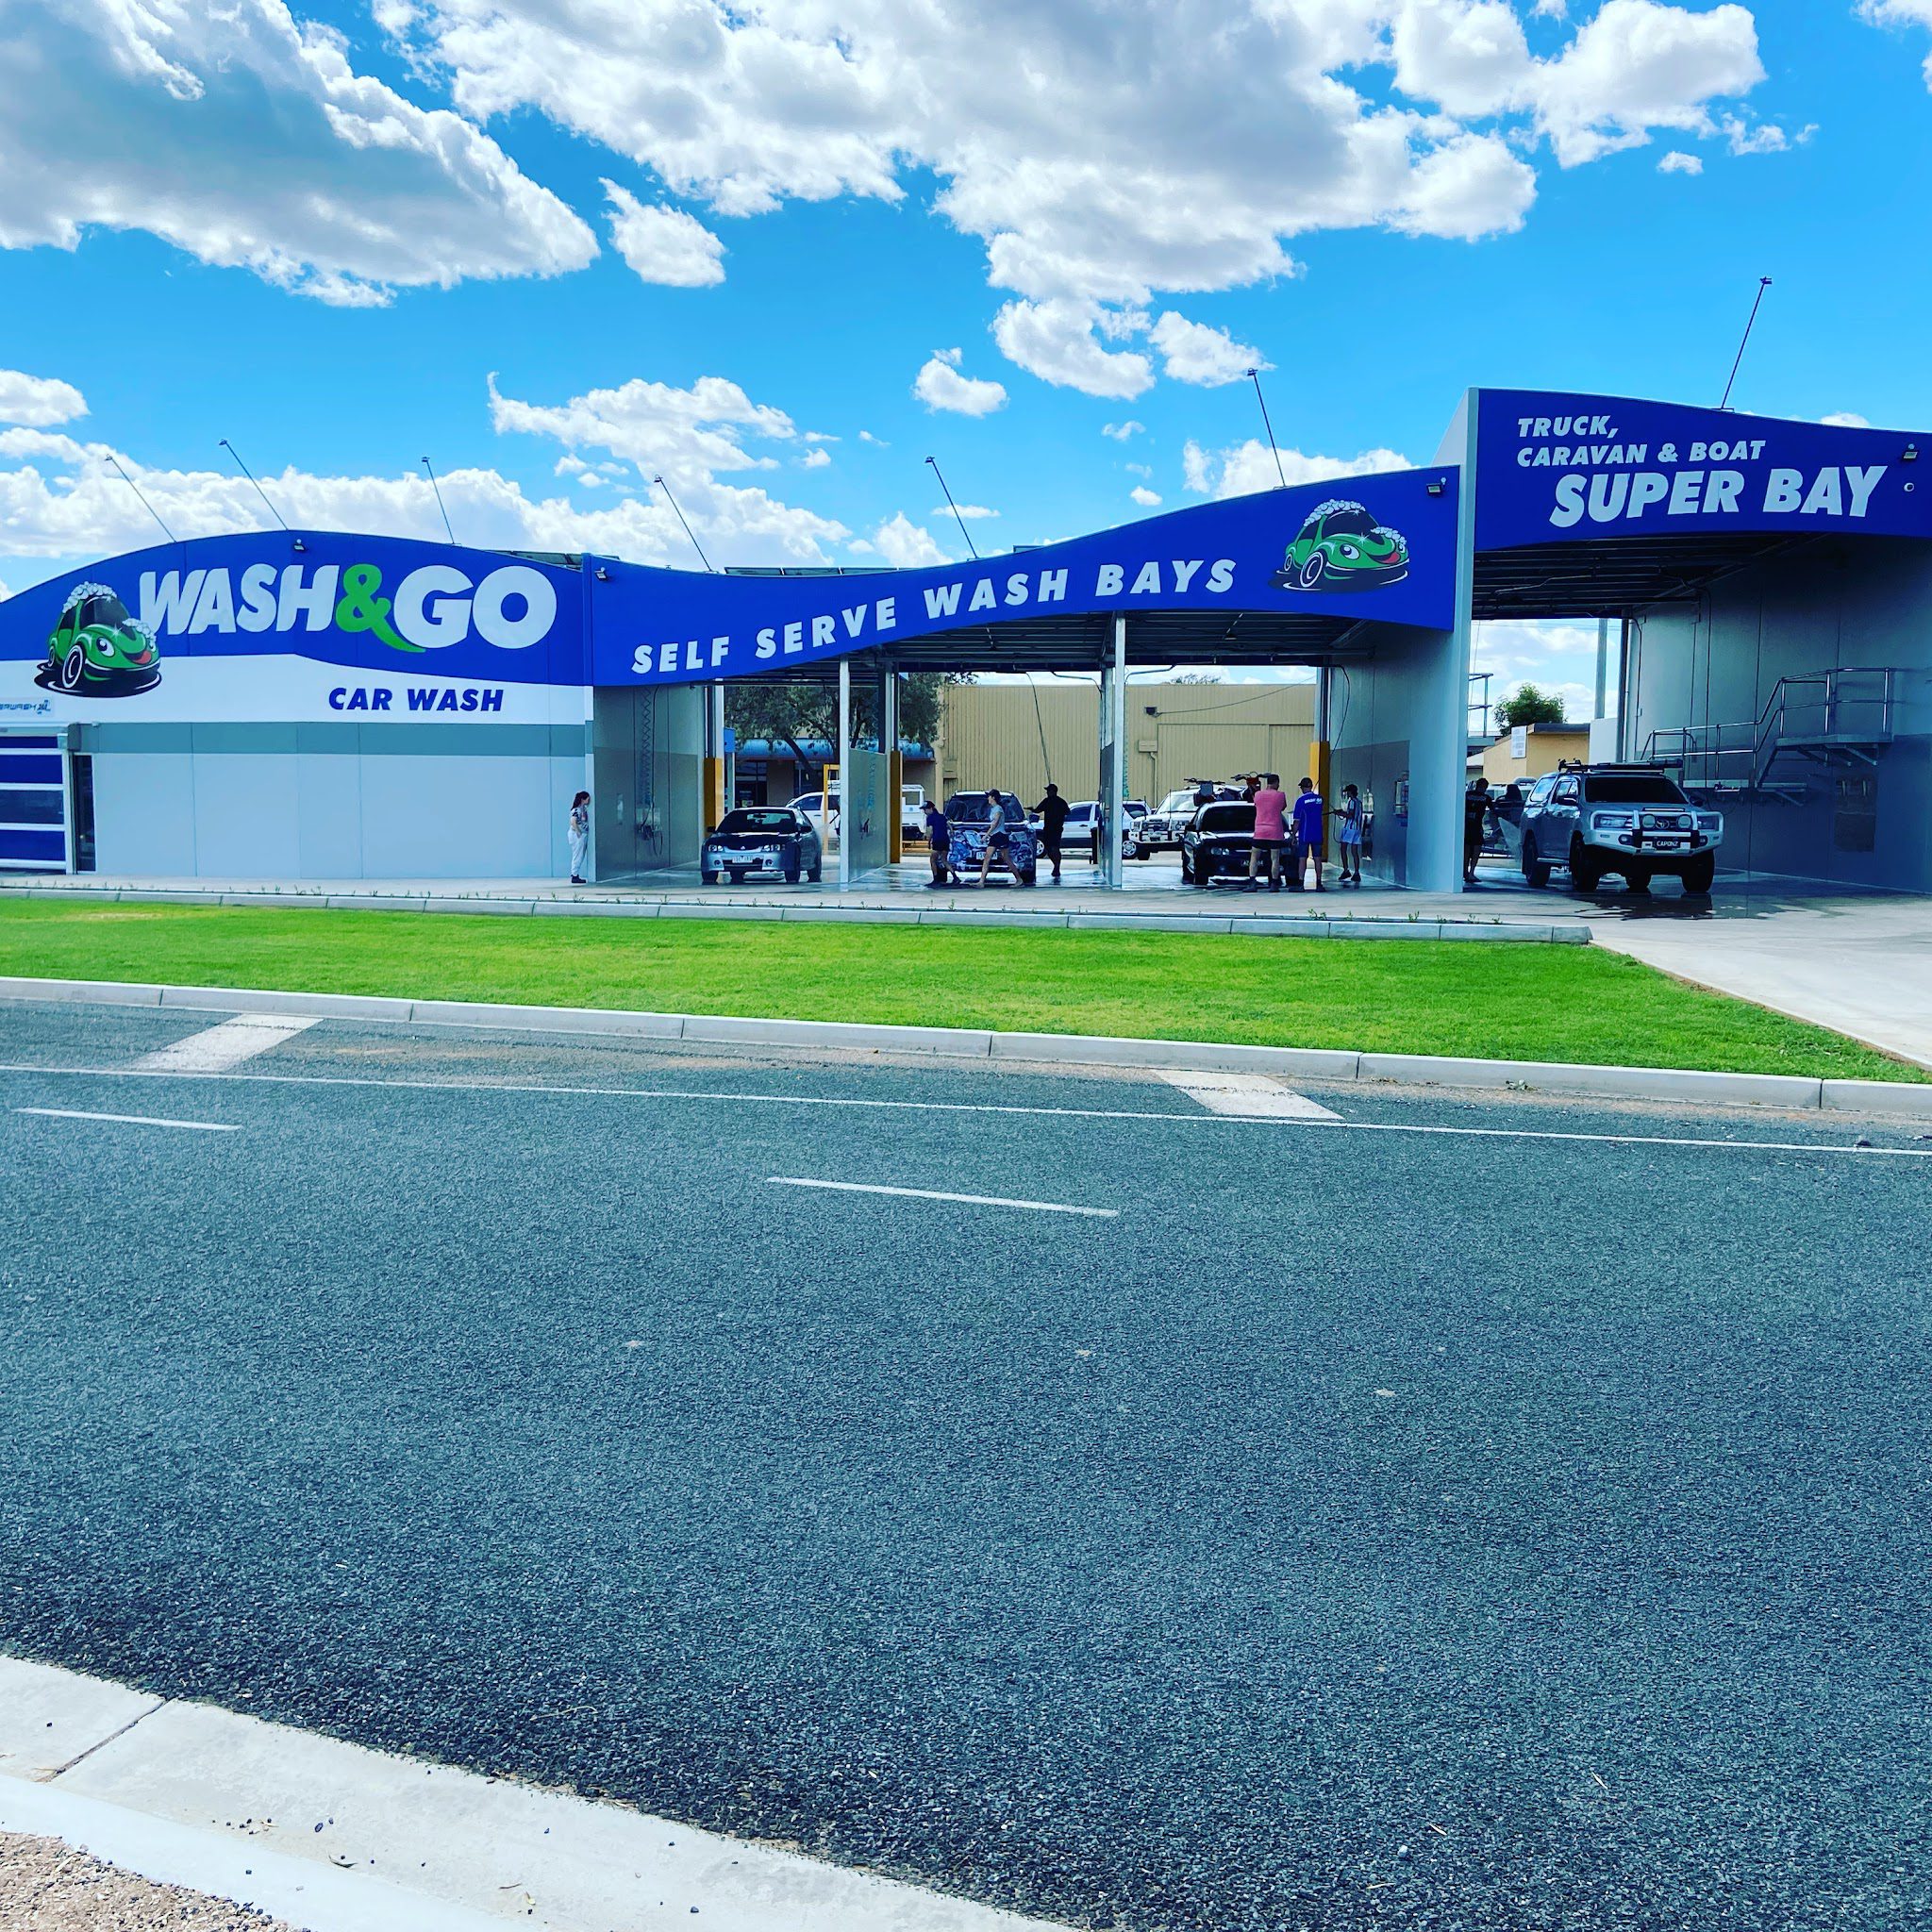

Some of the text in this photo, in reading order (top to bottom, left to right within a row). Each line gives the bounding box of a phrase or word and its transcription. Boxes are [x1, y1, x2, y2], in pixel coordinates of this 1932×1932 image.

[1518, 416, 1618, 438] TRUCK,
[1518, 441, 1766, 467] CARAVAN & BOAT
[1549, 466, 1888, 527] SUPER BAY
[632, 559, 1236, 674] SELF SERVE WASH BAYS
[329, 688, 504, 711] CAR WASH
